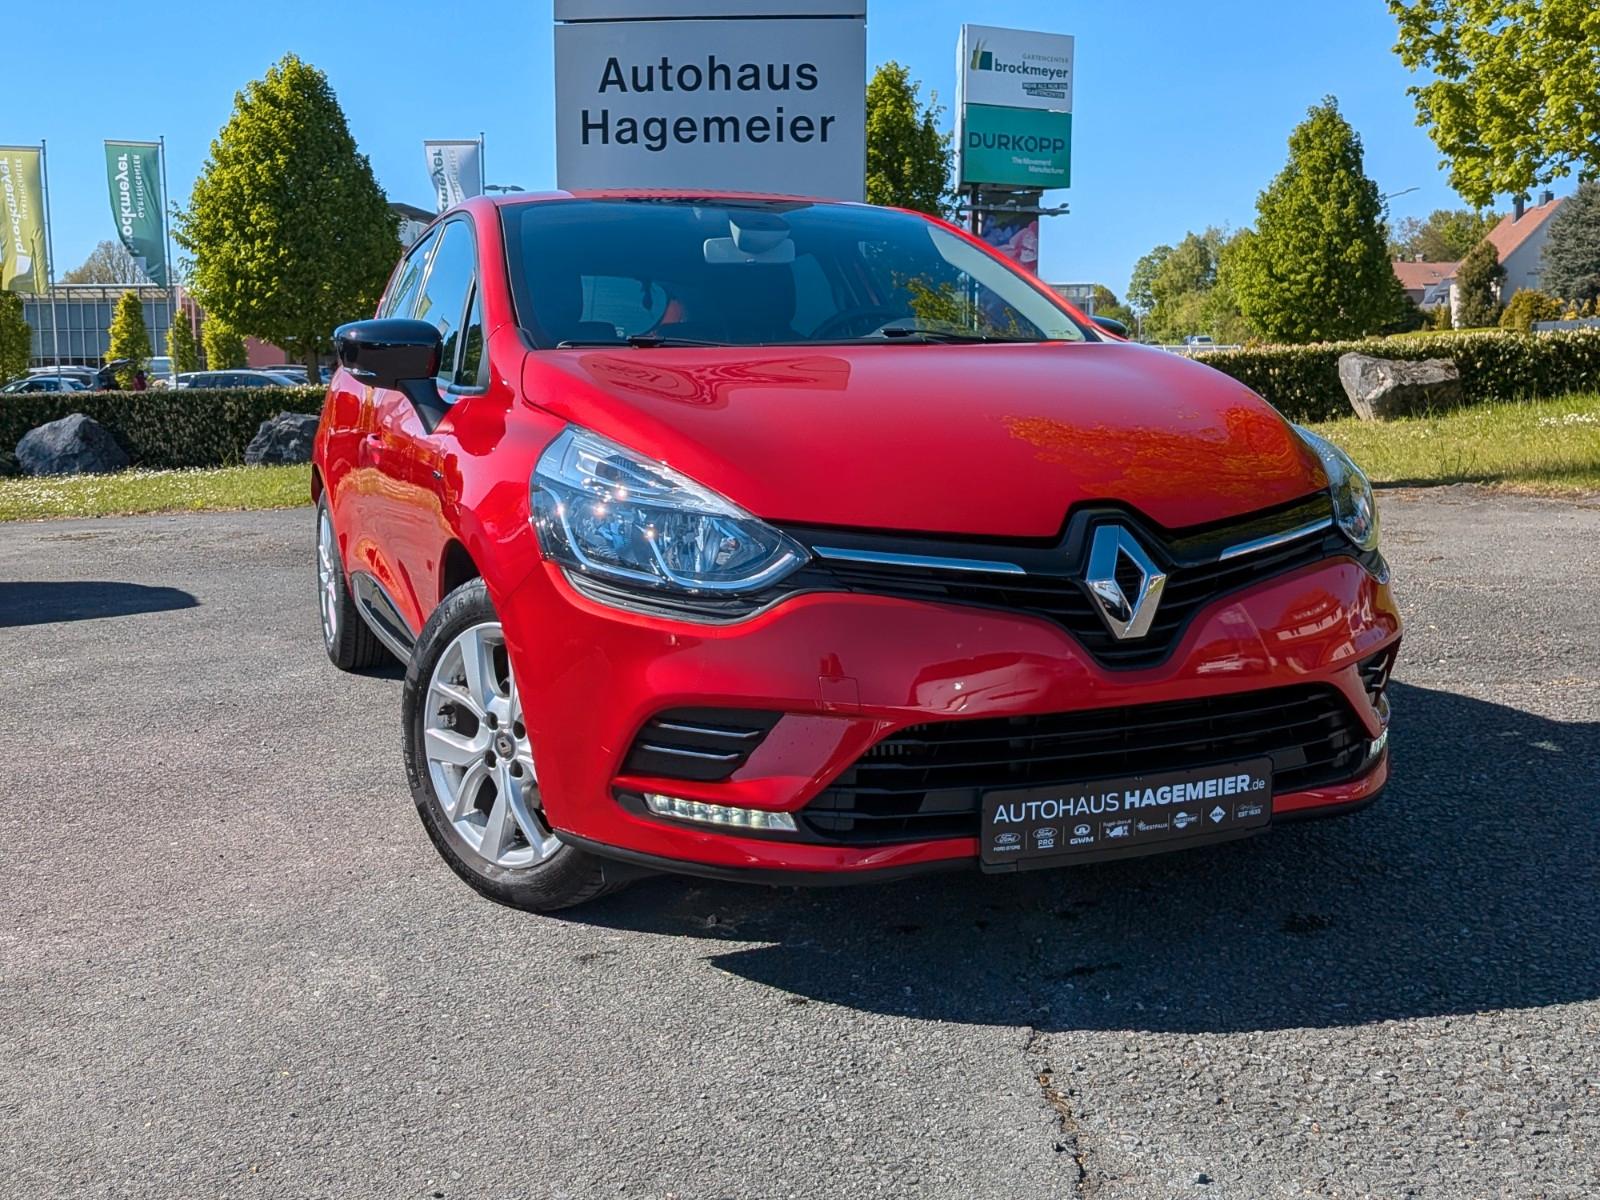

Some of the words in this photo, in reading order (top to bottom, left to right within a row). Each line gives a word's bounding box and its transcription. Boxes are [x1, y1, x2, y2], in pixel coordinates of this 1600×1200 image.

[598, 55, 820, 93] Autohaus
[995, 58, 1069, 80] brockmeyer
[581, 106, 836, 152] Hagemeier
[992, 792, 1120, 824] AUTOHAUS
[1123, 773, 1266, 810] HAGEMEIER.de
[1037, 838, 1054, 847] PRO
[1069, 836, 1094, 845] GWM
